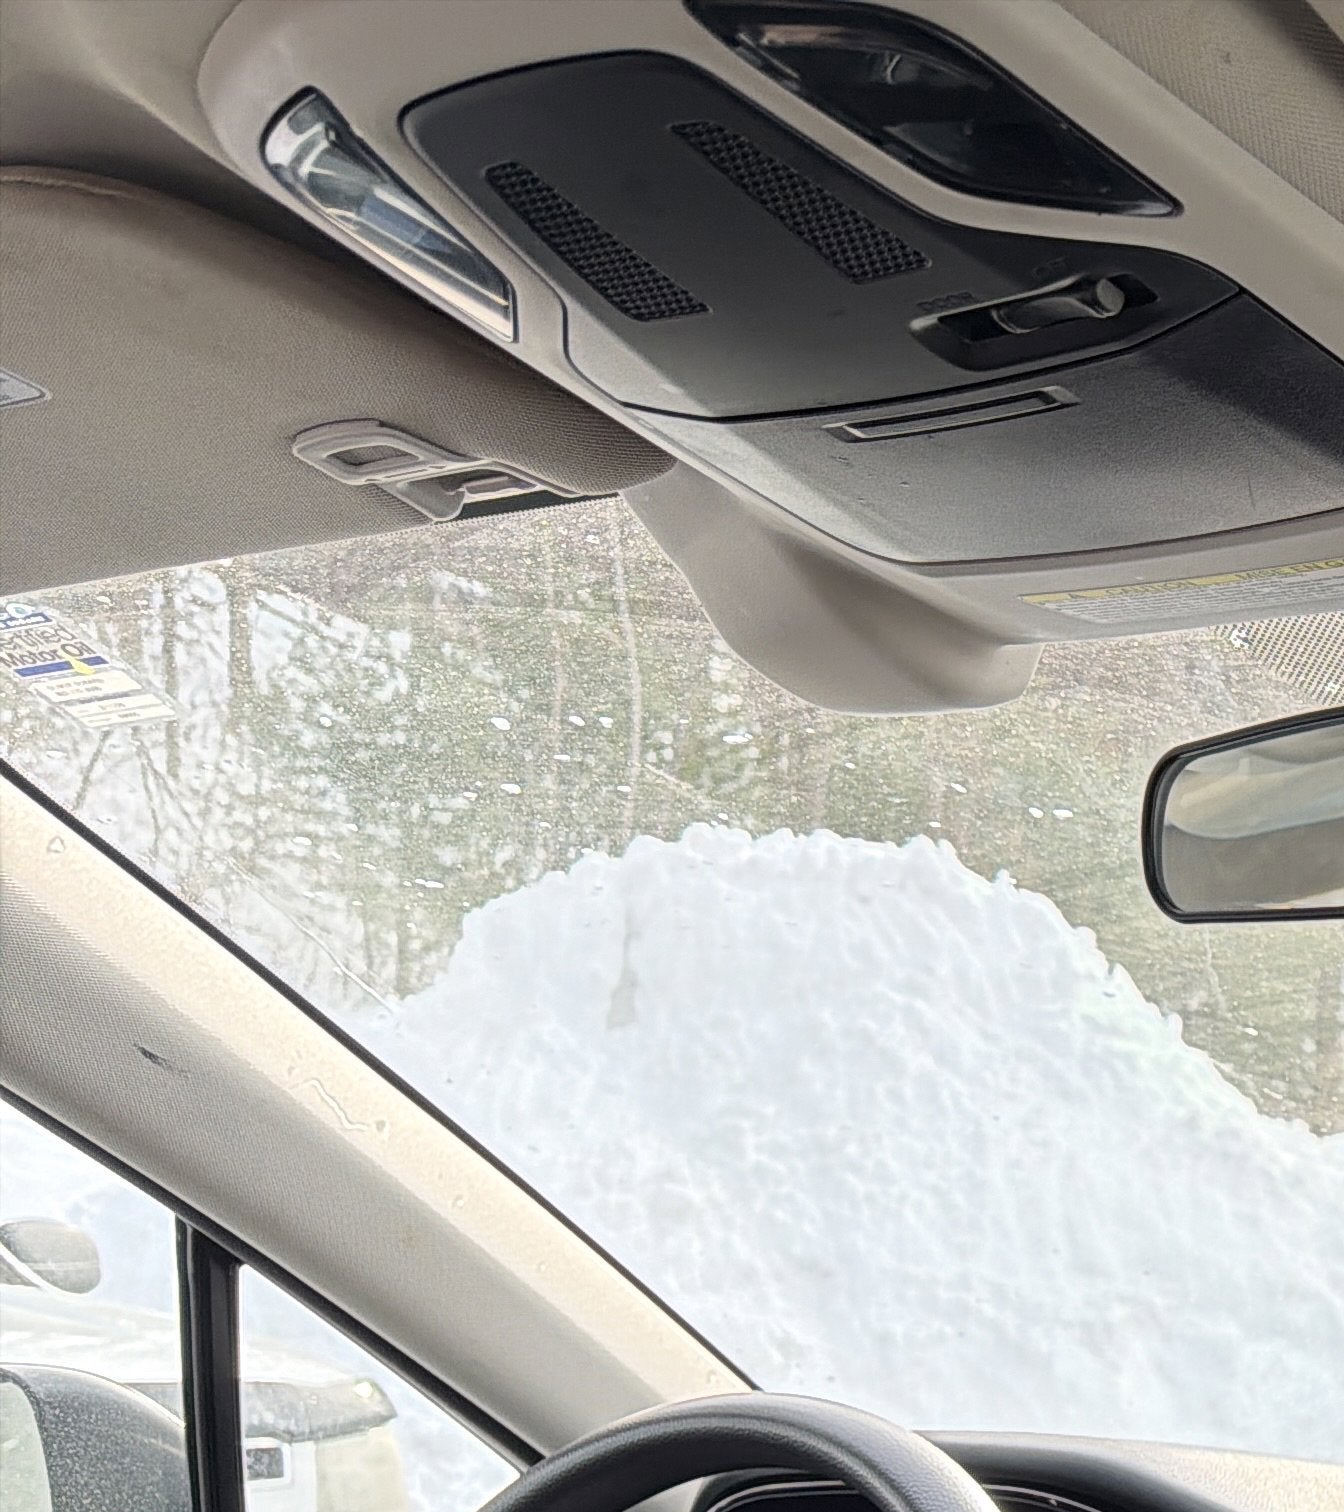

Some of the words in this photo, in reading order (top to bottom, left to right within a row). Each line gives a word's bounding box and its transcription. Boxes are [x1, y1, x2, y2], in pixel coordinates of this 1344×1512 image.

[1292, 562, 1321, 573] EN
[0, 649, 60, 669] Motor
[60, 641, 97, 657] Oil
